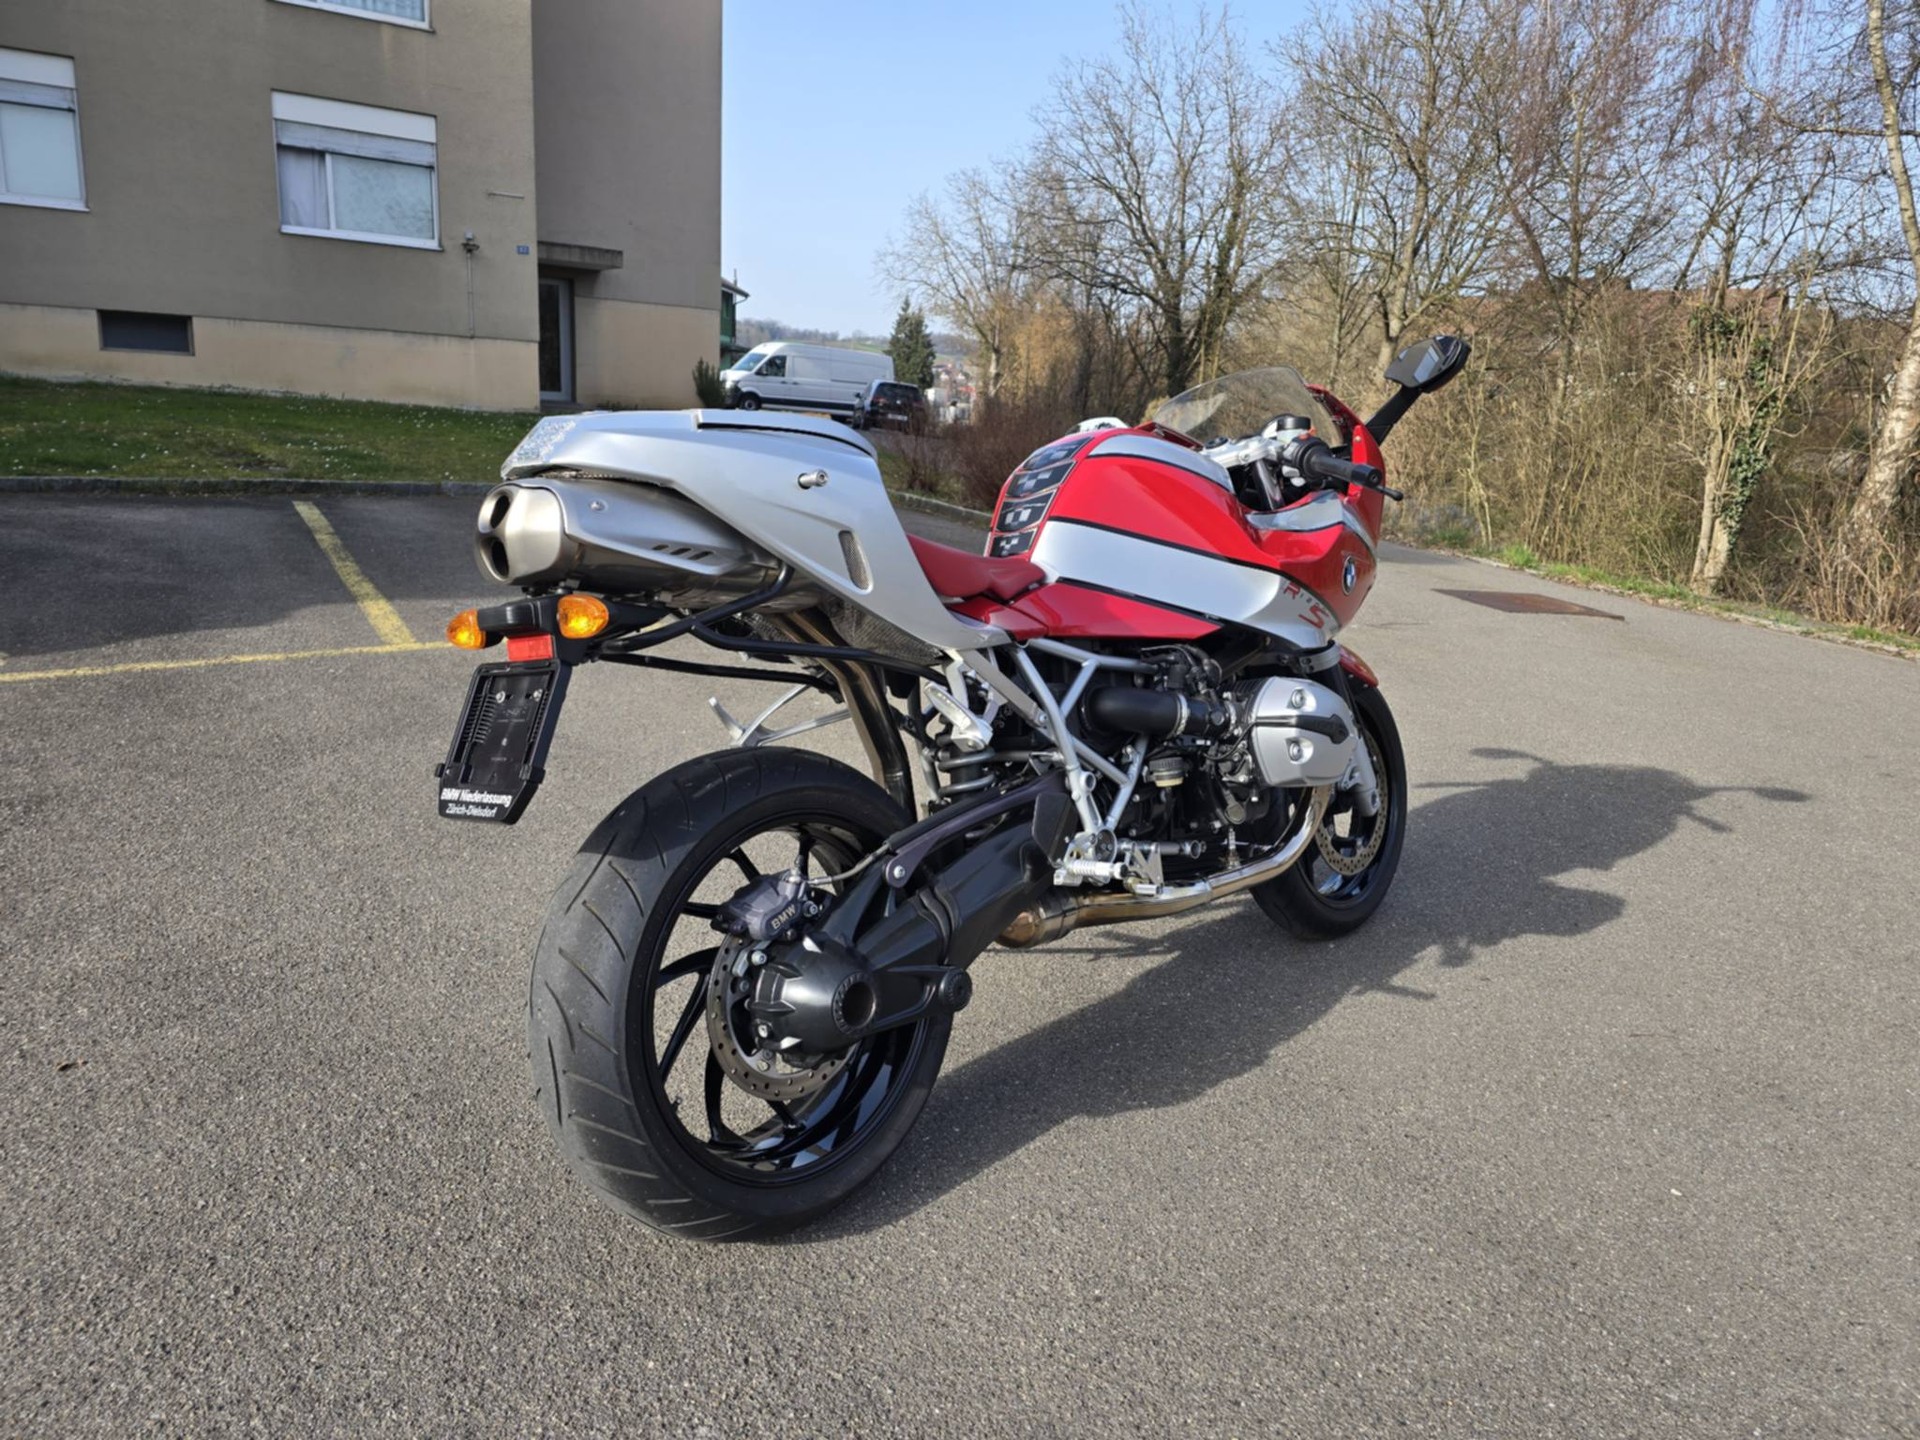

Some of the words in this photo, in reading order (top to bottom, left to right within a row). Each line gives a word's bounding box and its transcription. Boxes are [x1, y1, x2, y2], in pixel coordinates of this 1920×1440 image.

[440, 787, 461, 801] BMW
[459, 788, 513, 809] Niederlassung
[771, 904, 797, 930] BMW
